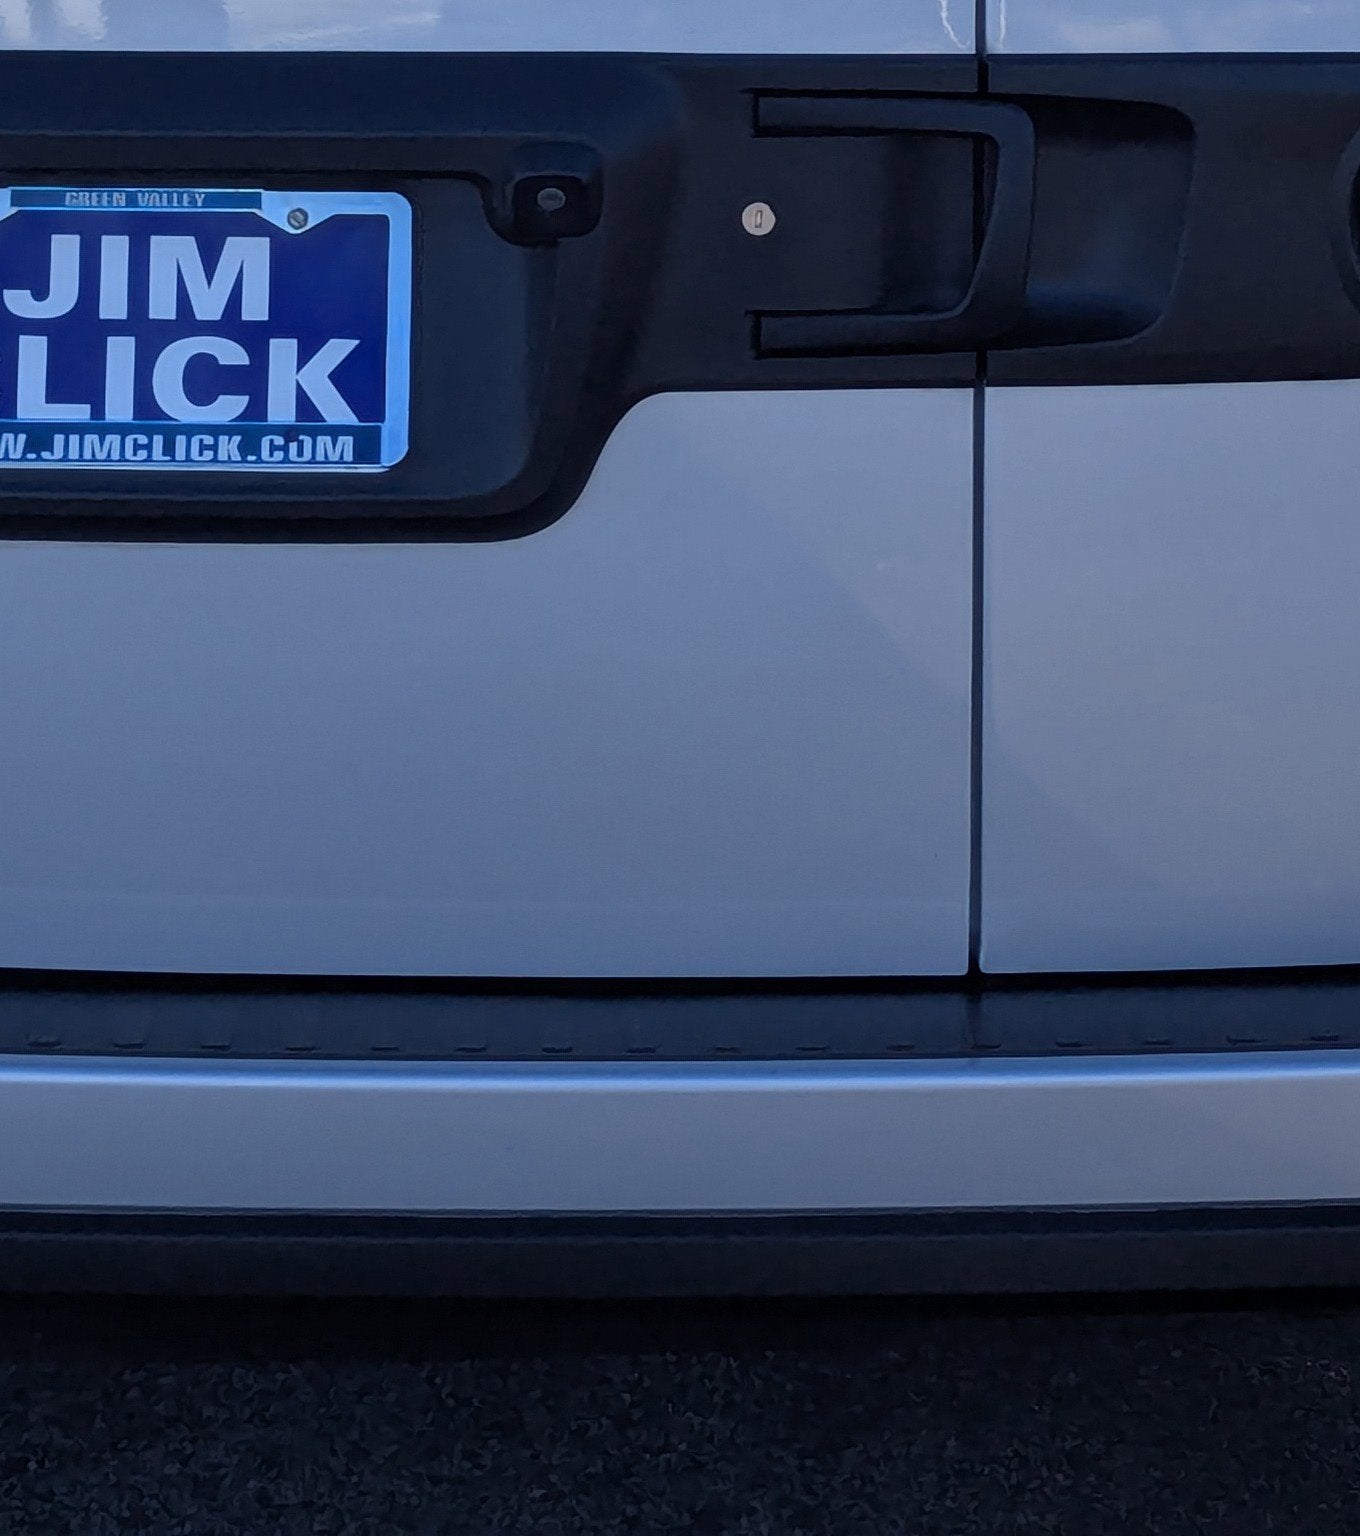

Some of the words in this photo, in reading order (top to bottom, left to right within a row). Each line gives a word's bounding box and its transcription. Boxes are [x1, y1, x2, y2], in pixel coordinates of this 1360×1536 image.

[64, 191, 126, 207] GREEN
[137, 192, 206, 208] VALLEY
[2, 233, 271, 321] JIM
